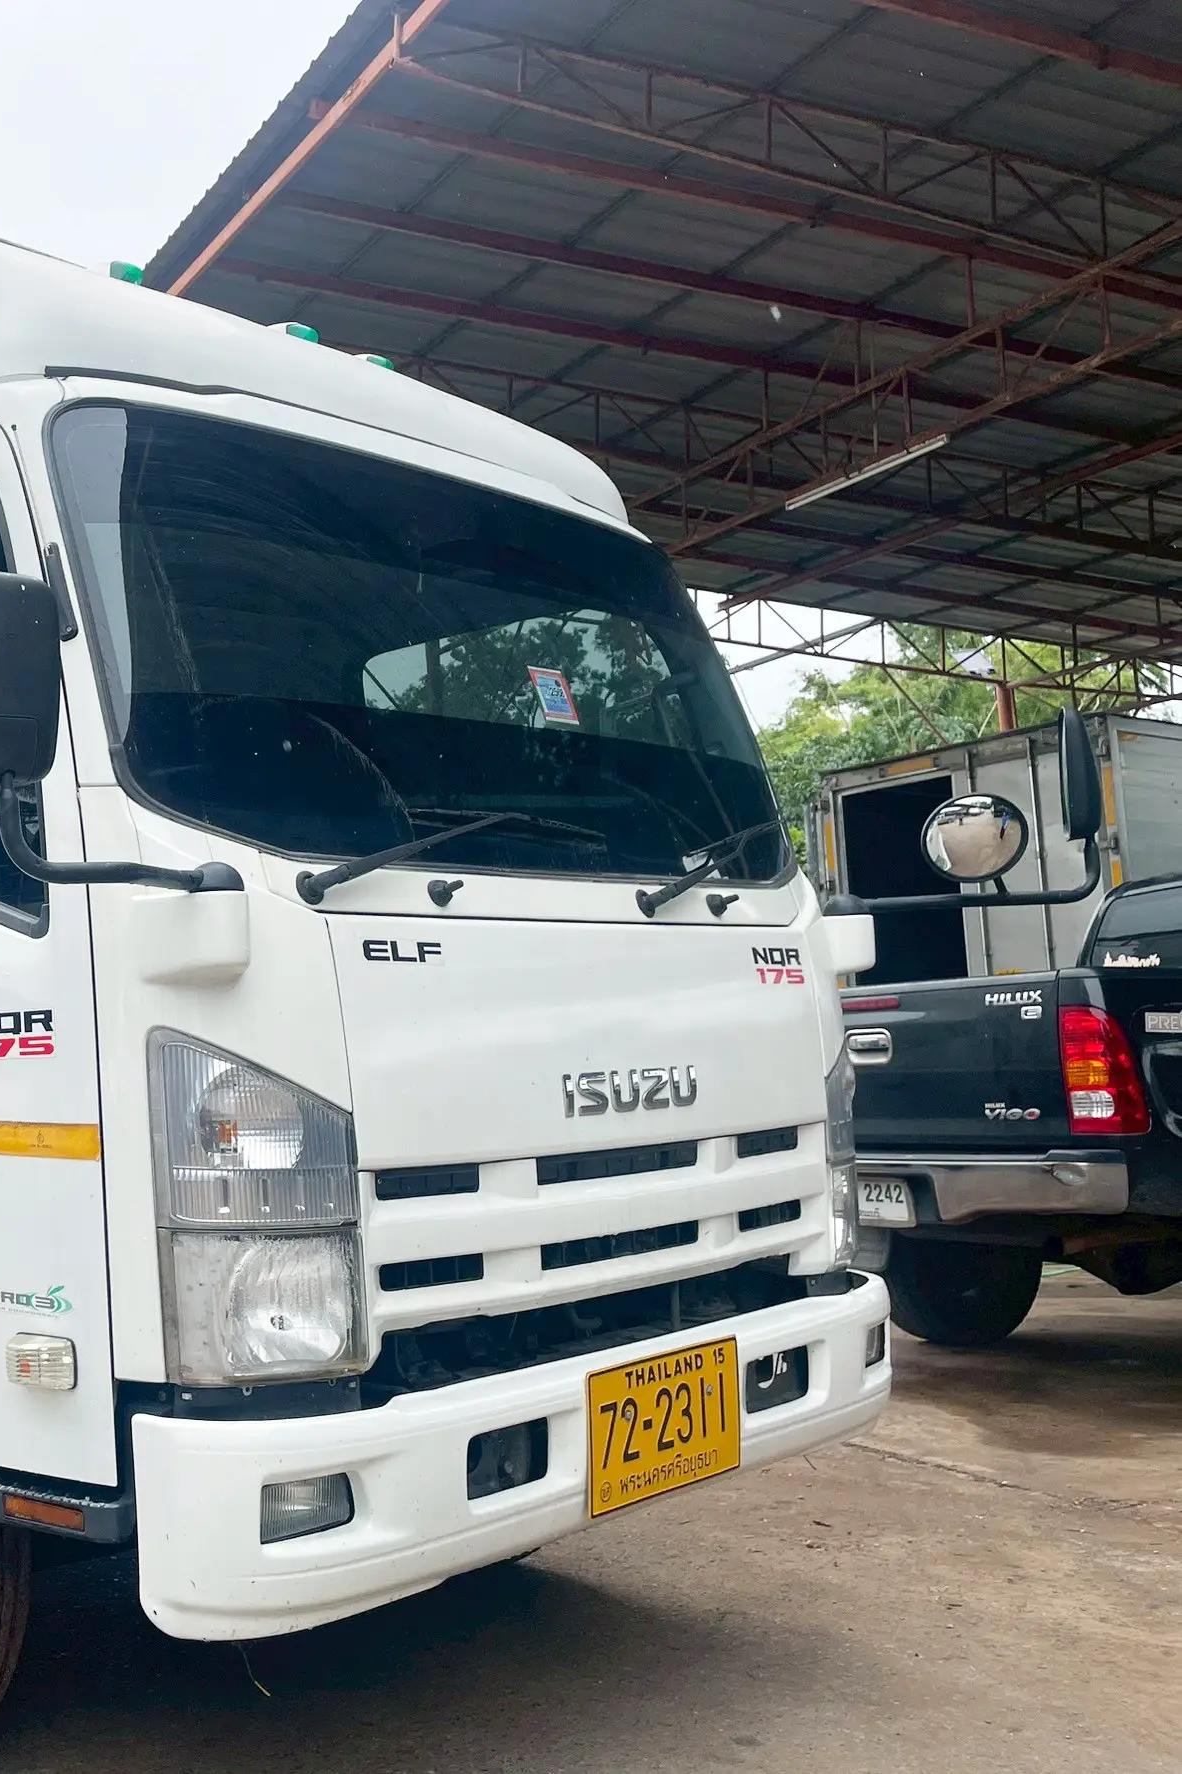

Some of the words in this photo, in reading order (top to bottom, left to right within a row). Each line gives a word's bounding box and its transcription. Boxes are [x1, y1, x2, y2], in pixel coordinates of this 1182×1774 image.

[362, 939, 442, 963] ELF
[751, 946, 802, 967] NQR
[756, 968, 805, 984] 175
[984, 989, 1043, 1006] HILUX
[1148, 1015, 1182, 1030] PRE
[562, 1065, 698, 1118] ISUZU
[984, 1107, 1041, 1121] VIGO
[863, 1183, 904, 1203] 2242
[624, 1353, 704, 1389] THAILAND
[712, 1347, 725, 1366] 15
[599, 1371, 726, 1470] 72-2311
[619, 1449, 718, 1495] พระนครศรีอยุธยา
